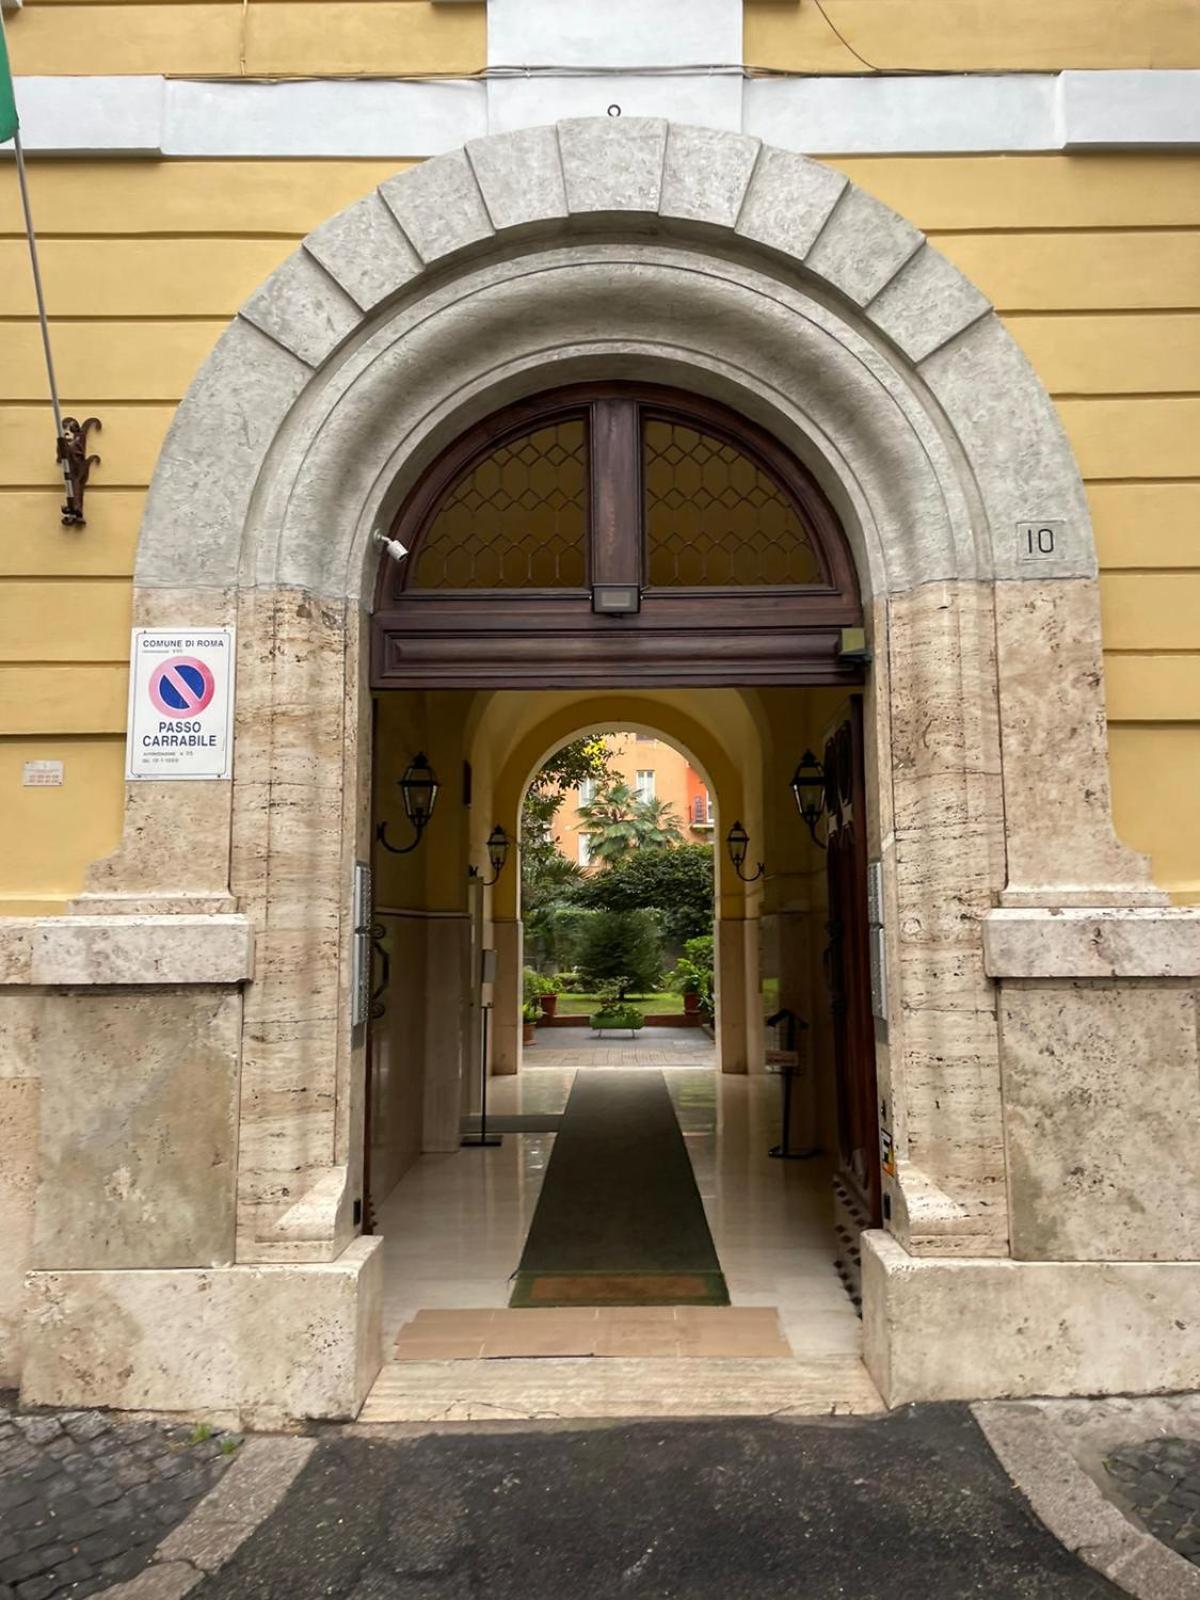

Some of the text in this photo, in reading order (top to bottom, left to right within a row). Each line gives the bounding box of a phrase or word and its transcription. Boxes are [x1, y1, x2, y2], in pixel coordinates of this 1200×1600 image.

[1028, 529, 1054, 553] 10
[143, 640, 224, 648] COMUNE DI ROMA
[159, 721, 202, 733] PASSO
[142, 735, 217, 747] CARRABILE
